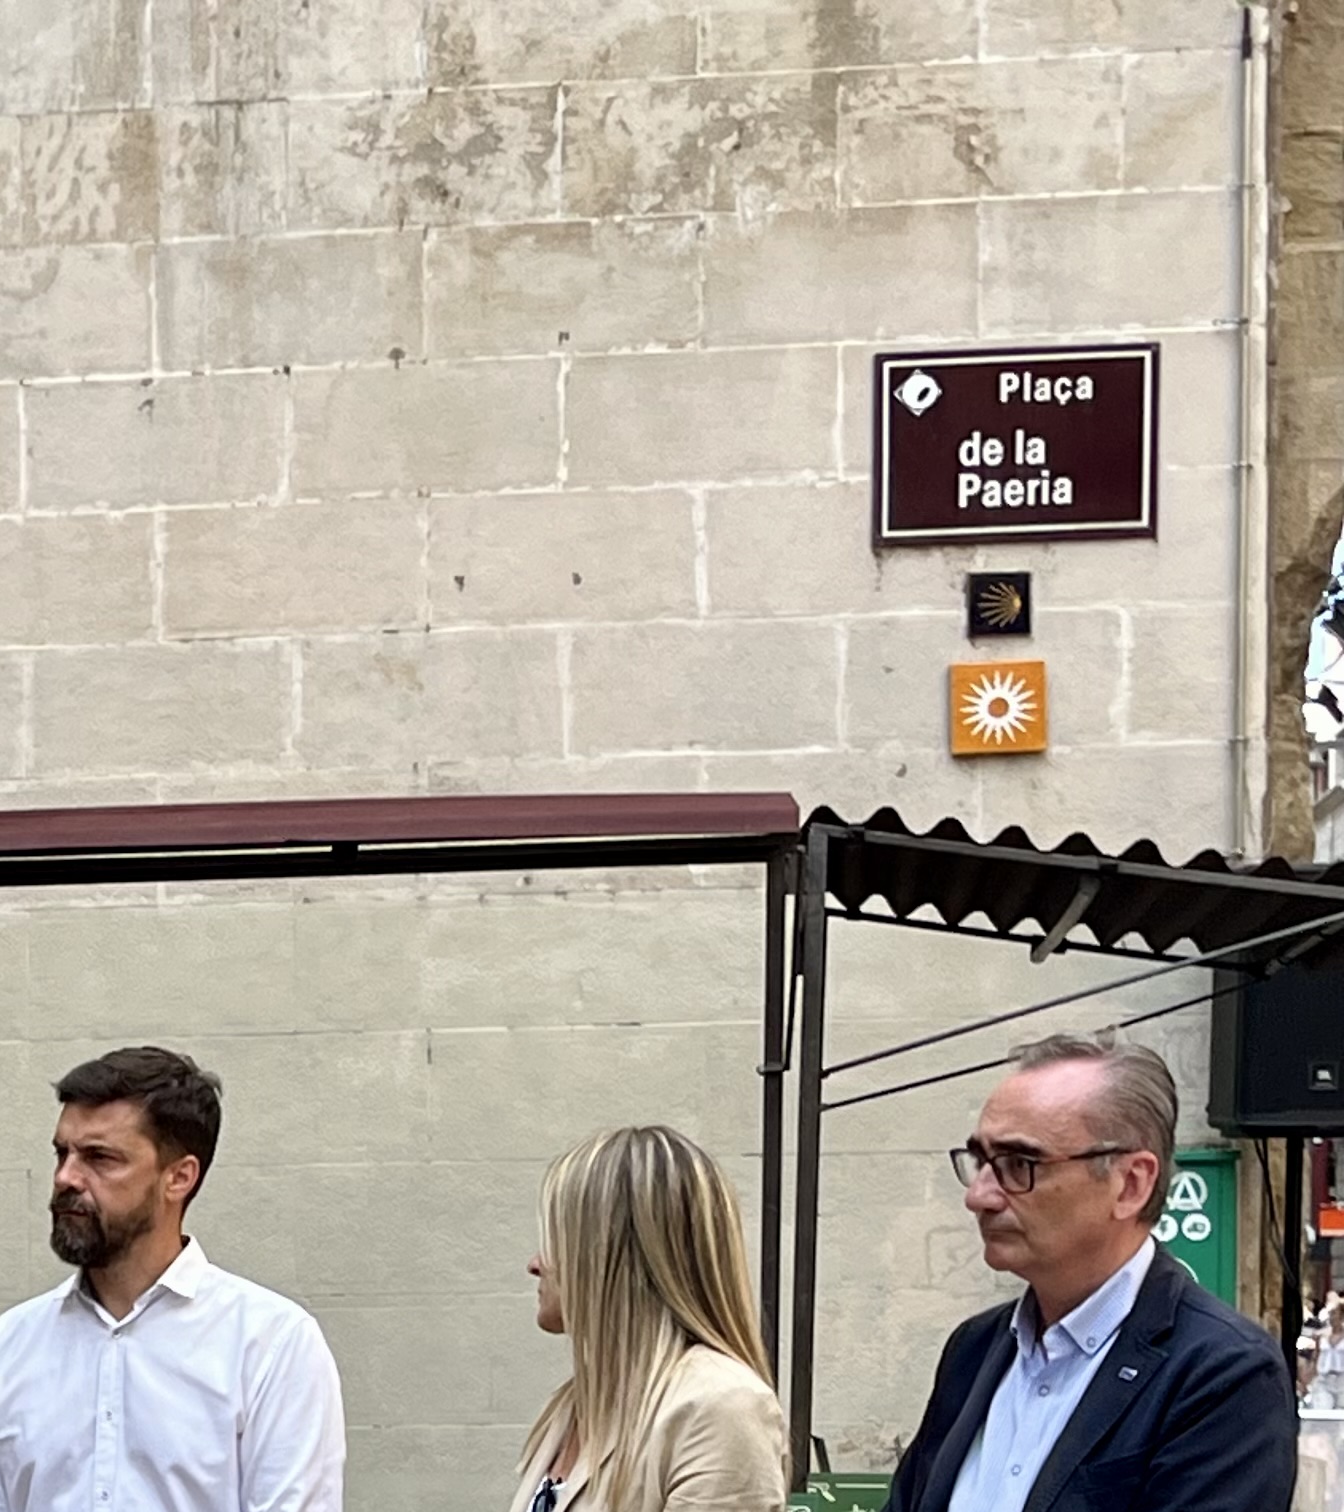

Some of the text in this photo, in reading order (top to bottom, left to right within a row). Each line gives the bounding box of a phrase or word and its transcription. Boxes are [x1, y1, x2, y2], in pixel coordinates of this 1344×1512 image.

[999, 371, 1094, 405] Plaça
[958, 429, 1046, 467] de la
[958, 469, 1073, 508] Paeria
